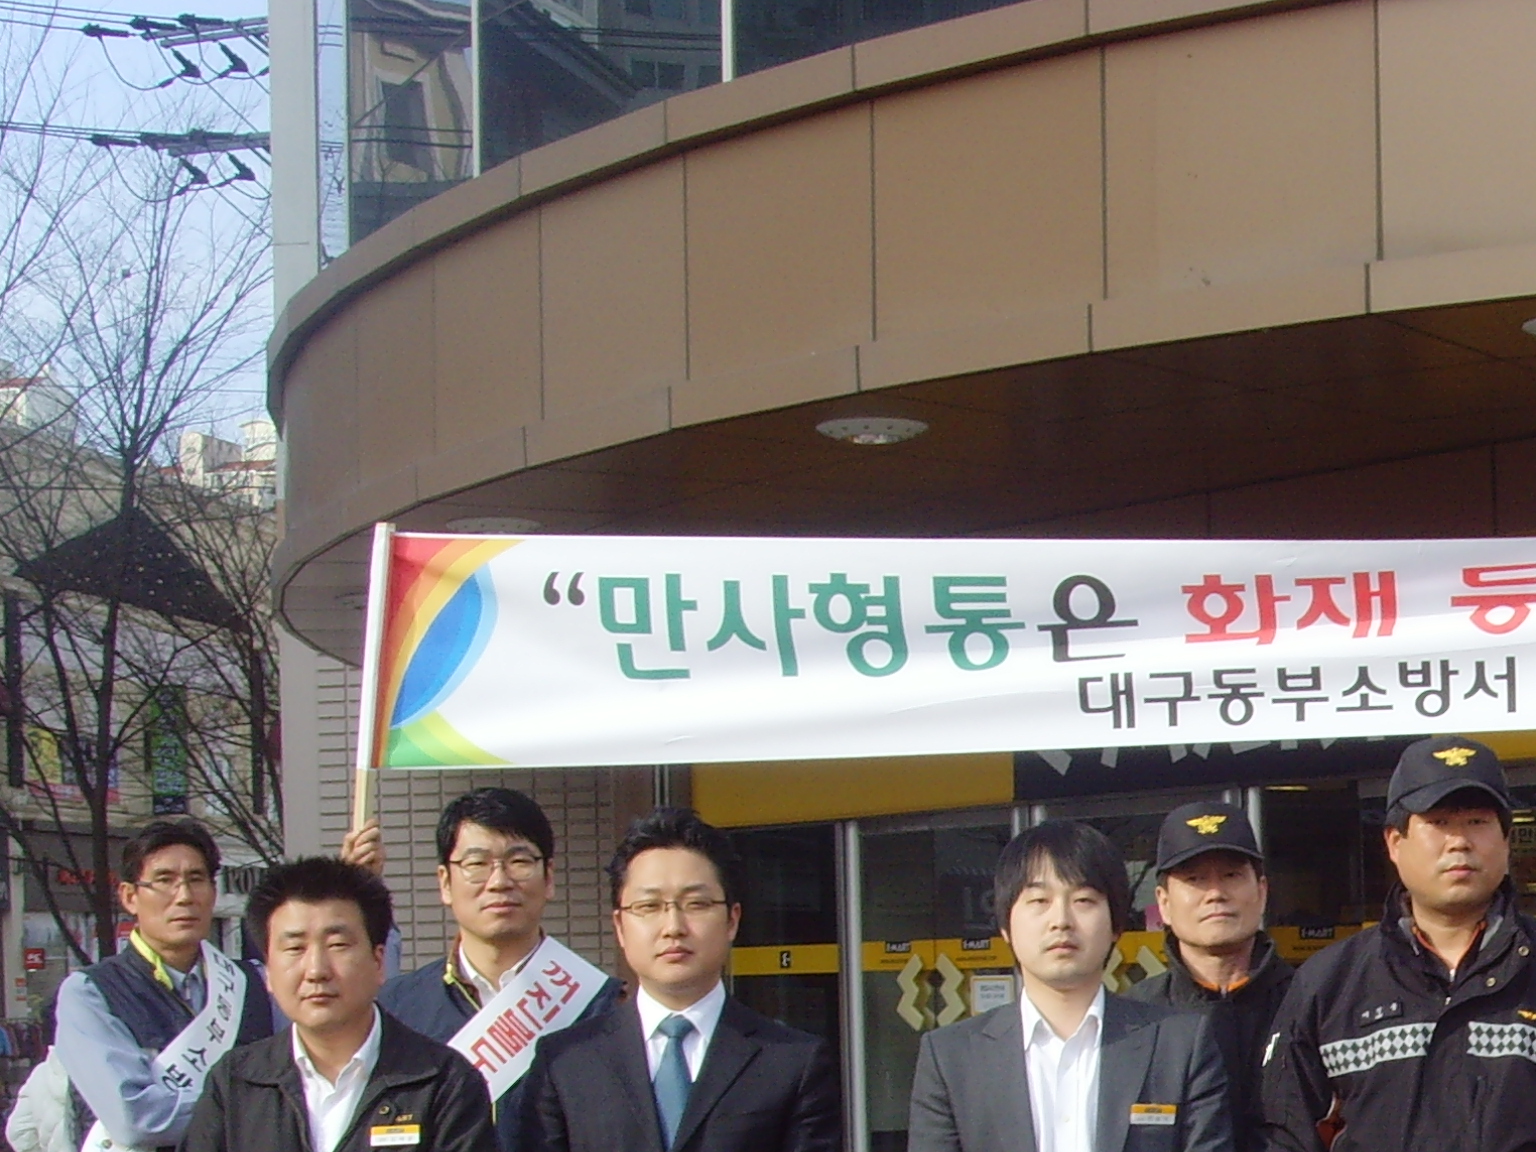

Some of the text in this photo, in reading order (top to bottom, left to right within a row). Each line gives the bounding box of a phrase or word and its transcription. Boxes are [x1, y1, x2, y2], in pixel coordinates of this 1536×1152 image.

[1182, 570, 1397, 645] 화재
[1078, 657, 1519, 729] 대구동부소방서
[470, 959, 581, 1073] 꺼진불도
